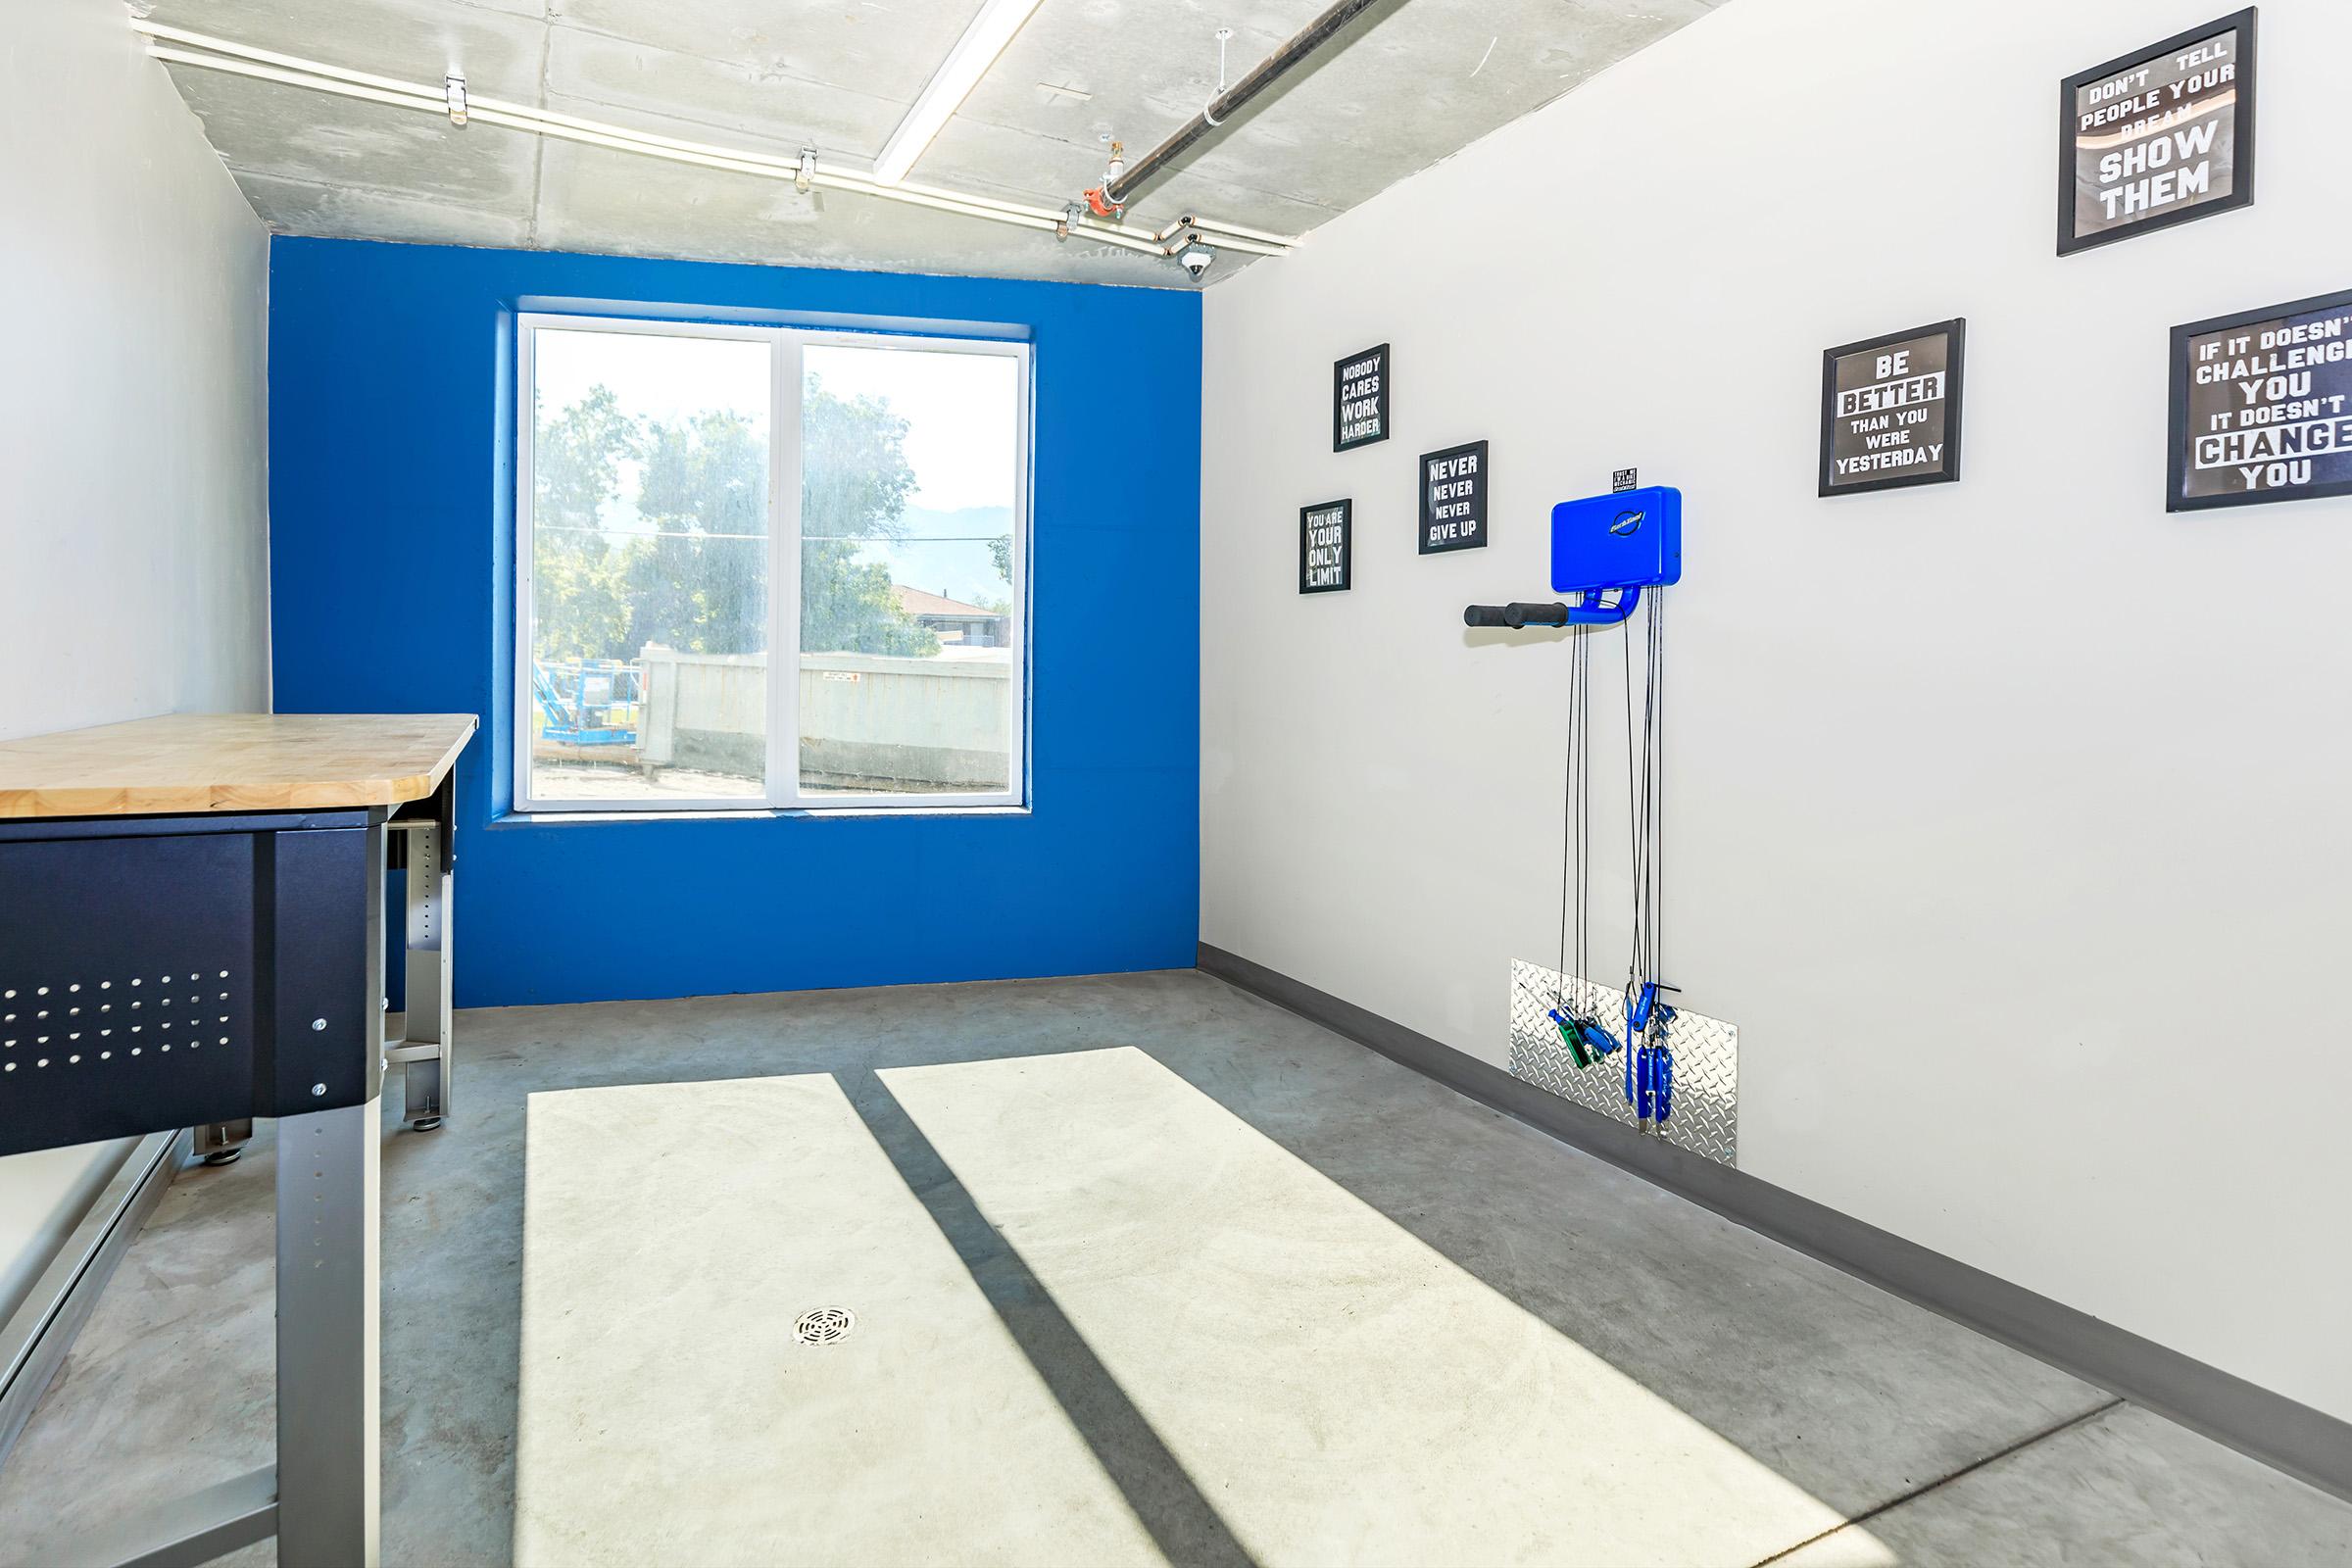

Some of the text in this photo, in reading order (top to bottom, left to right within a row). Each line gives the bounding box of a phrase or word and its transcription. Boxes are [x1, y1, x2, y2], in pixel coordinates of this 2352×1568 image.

[2088, 42, 2228, 105] DON'T TELL
[2081, 63, 2235, 131] PEOPLE YOUR
[2121, 102, 2193, 140] DREAM
[2099, 120, 2219, 184] SHOW
[2099, 161, 2209, 220] THEM
[2199, 316, 2352, 362] IF IT DOESN'
[1343, 356, 1381, 382] NOBODY
[1876, 350, 1910, 379] BE
[1342, 375, 1380, 402] CARES
[1842, 375, 1938, 416] BETTER
[2238, 370, 2311, 405] YOU
[1342, 396, 1380, 422] WORK
[1850, 408, 1928, 434] THAN YOU
[2210, 395, 2345, 431] IT DOESN'T
[1342, 417, 1380, 440] HARDER
[1866, 429, 1910, 450] WERE
[2199, 419, 2352, 466] CHANGE
[1430, 455, 1478, 482] NEVER
[1836, 443, 1943, 475] YESTERDAY
[2238, 459, 2311, 490] YOU
[1434, 479, 1473, 502] NEVER
[1307, 511, 1343, 528] YOU ARE
[1436, 501, 1470, 520] NEVER
[1308, 525, 1342, 548] YOUR
[1430, 519, 1477, 541] GIVE UP
[1308, 546, 1343, 567] ONLY
[1309, 565, 1342, 586] LIMIT
